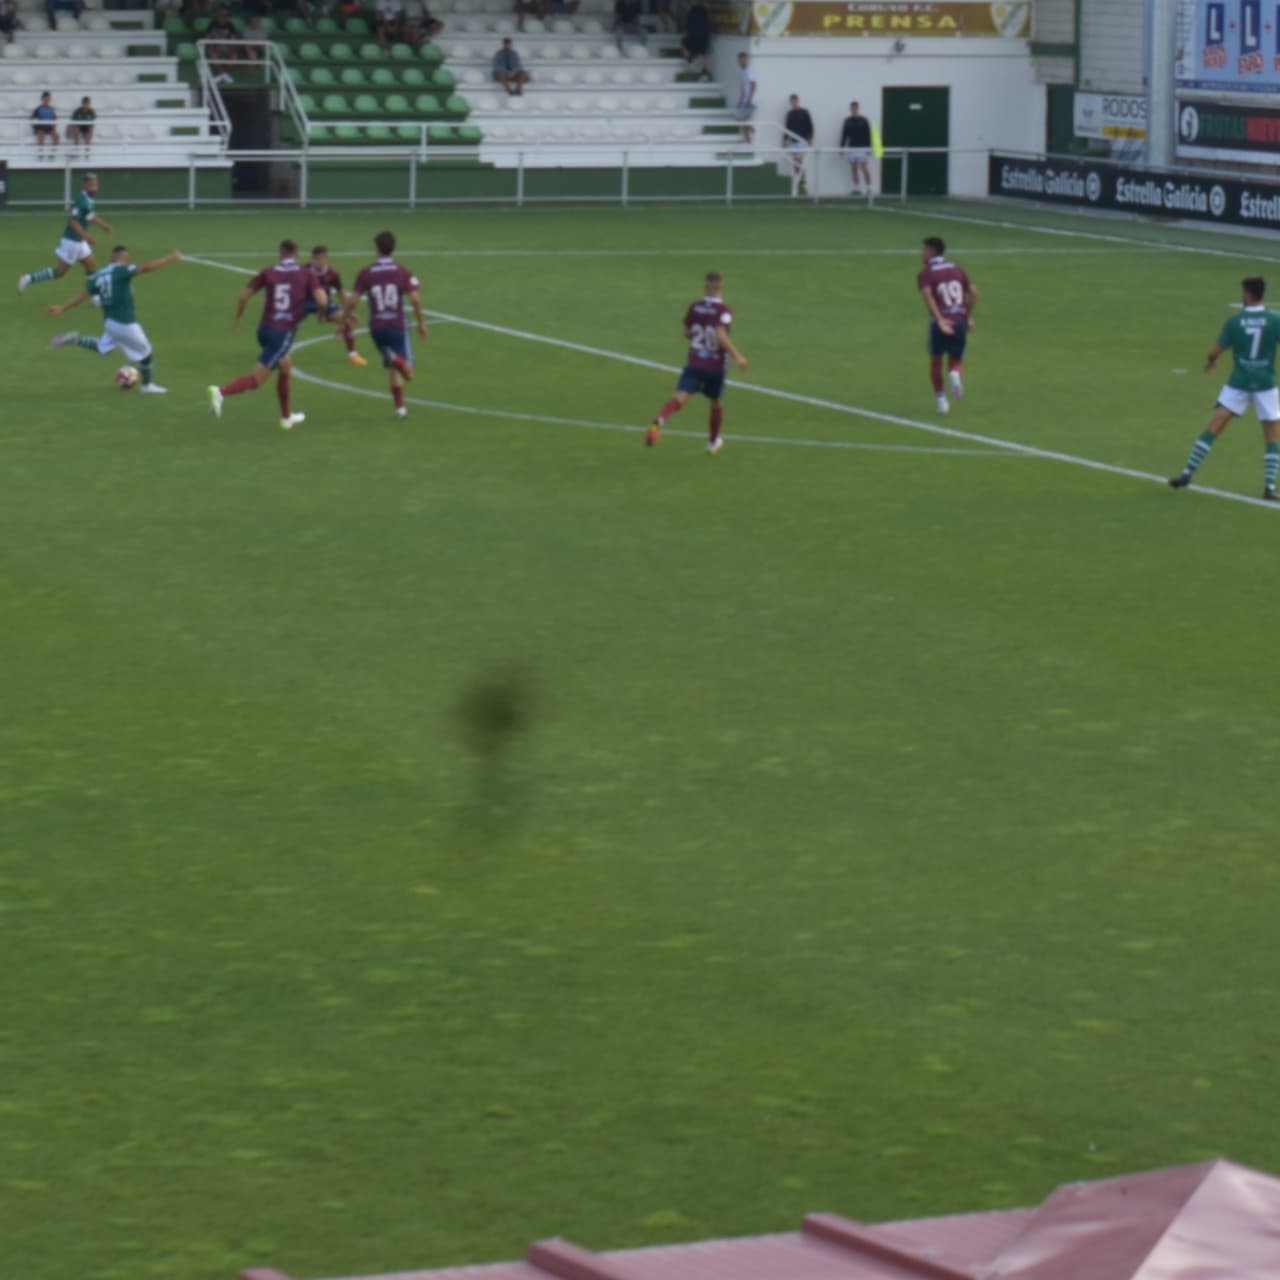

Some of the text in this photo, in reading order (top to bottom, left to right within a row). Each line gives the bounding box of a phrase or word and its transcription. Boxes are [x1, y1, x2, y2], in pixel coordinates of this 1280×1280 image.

[823, 14, 959, 29] PRENSA
[1209, 6, 1221, 41] L
[1245, 4, 1257, 48] L
[1001, 165, 1085, 198] Estrella Galicia
[1115, 176, 1208, 213] Estrella Galicia
[274, 283, 291, 310] 5
[371, 283, 399, 312] 14
[937, 279, 964, 308] 19
[691, 323, 720, 352] 20
[1245, 326, 1262, 361] 7
